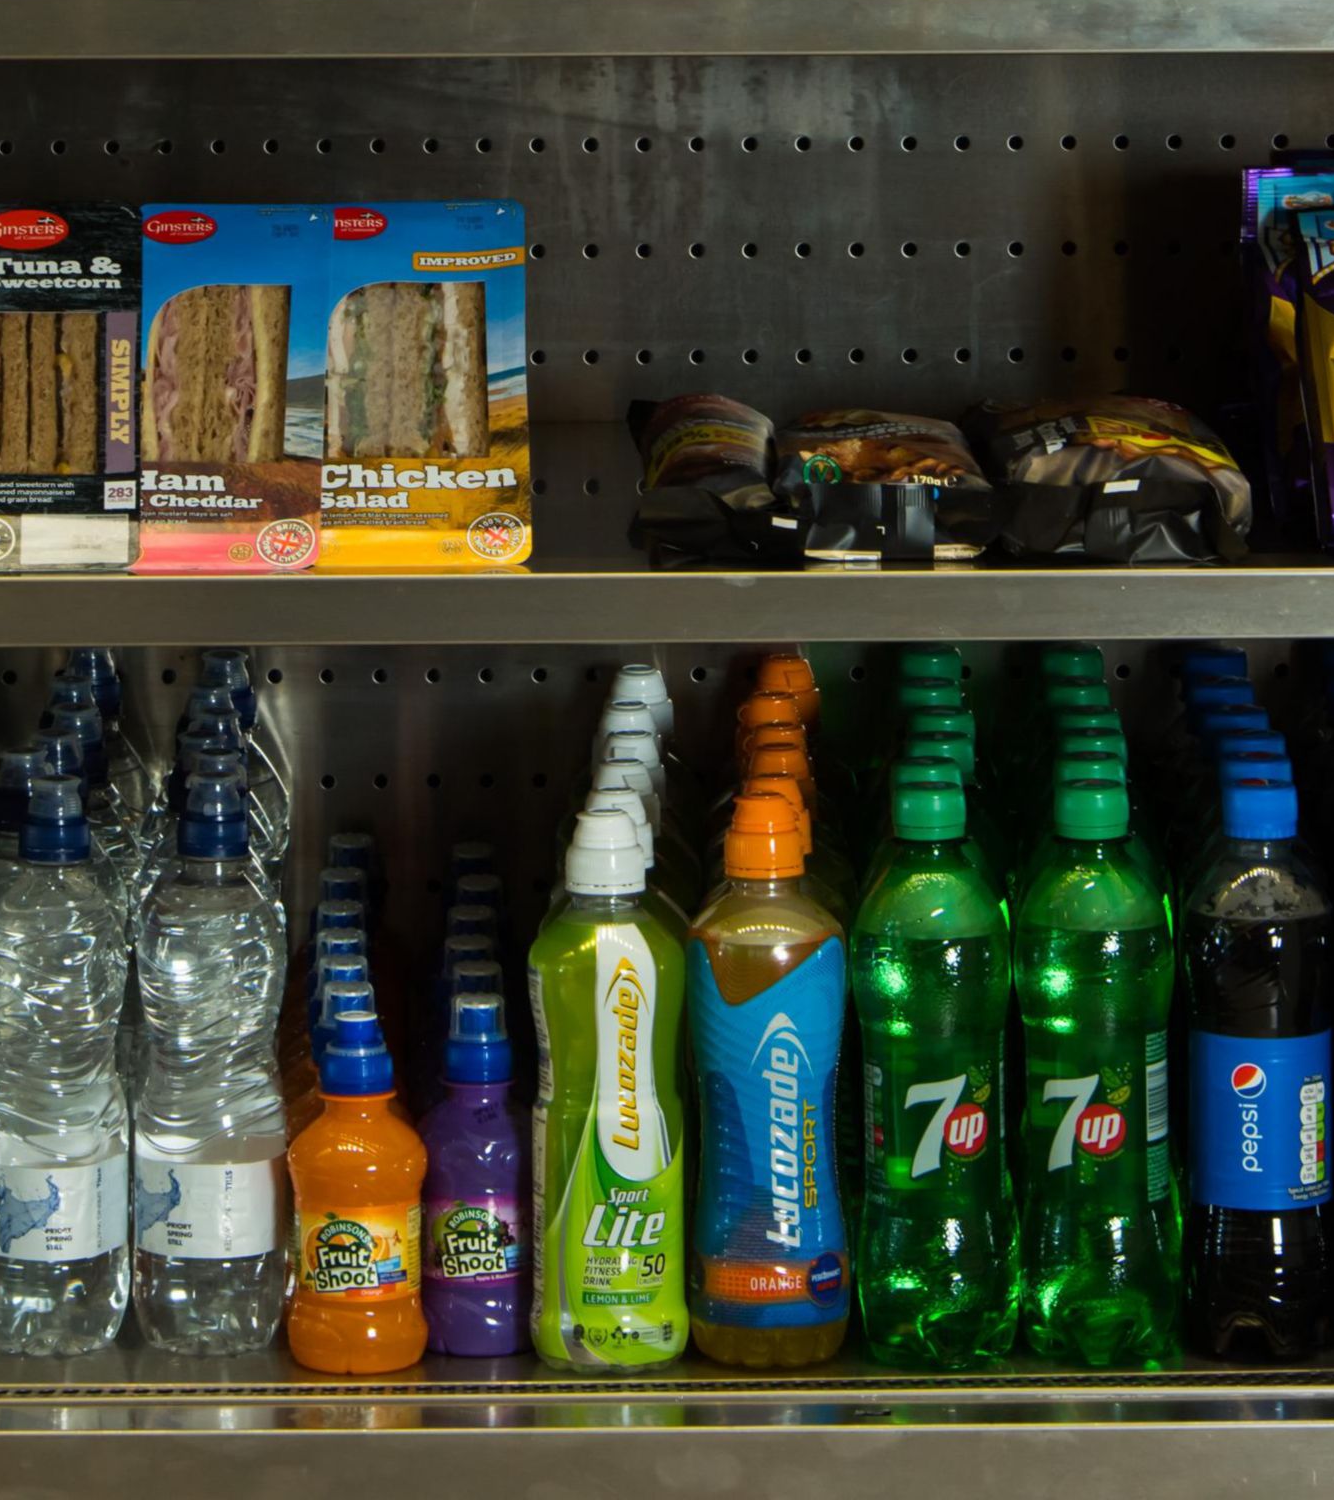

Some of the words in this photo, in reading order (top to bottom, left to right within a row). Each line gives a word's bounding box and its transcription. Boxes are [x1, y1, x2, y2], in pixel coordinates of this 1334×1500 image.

[89, 256, 123, 276] &
[417, 252, 517, 267] IMPROVED
[109, 338, 132, 445] SIMPLY
[15, 481, 56, 489] sweetcorn
[321, 463, 518, 490] Chicken
[7, 496, 28, 505] grain
[17, 489, 64, 497] mayonnaise
[107, 487, 133, 498] 283
[149, 493, 263, 509] Cheddar
[320, 491, 409, 509] Salad
[611, 981, 641, 1152] Lucozade
[1238, 1102, 1264, 1173] pepsi
[766, 1047, 800, 1249] Lucozade
[803, 1099, 818, 1209] SPORT
[607, 1186, 650, 1206] Sport
[581, 1204, 666, 1249] Lite
[446, 1231, 498, 1254] Fruit
[318, 1245, 371, 1269] Fruit
[443, 1252, 505, 1276] Shoot
[586, 1255, 638, 1268] HYDRATING
[640, 1251, 666, 1276] 50
[317, 1266, 377, 1290] Shoot
[584, 1266, 623, 1276] FITNESS
[582, 1276, 613, 1287] DRINK
[750, 1275, 803, 1291] ORANGE
[585, 1294, 618, 1305] LEMON
[629, 1293, 653, 1304] LIME
